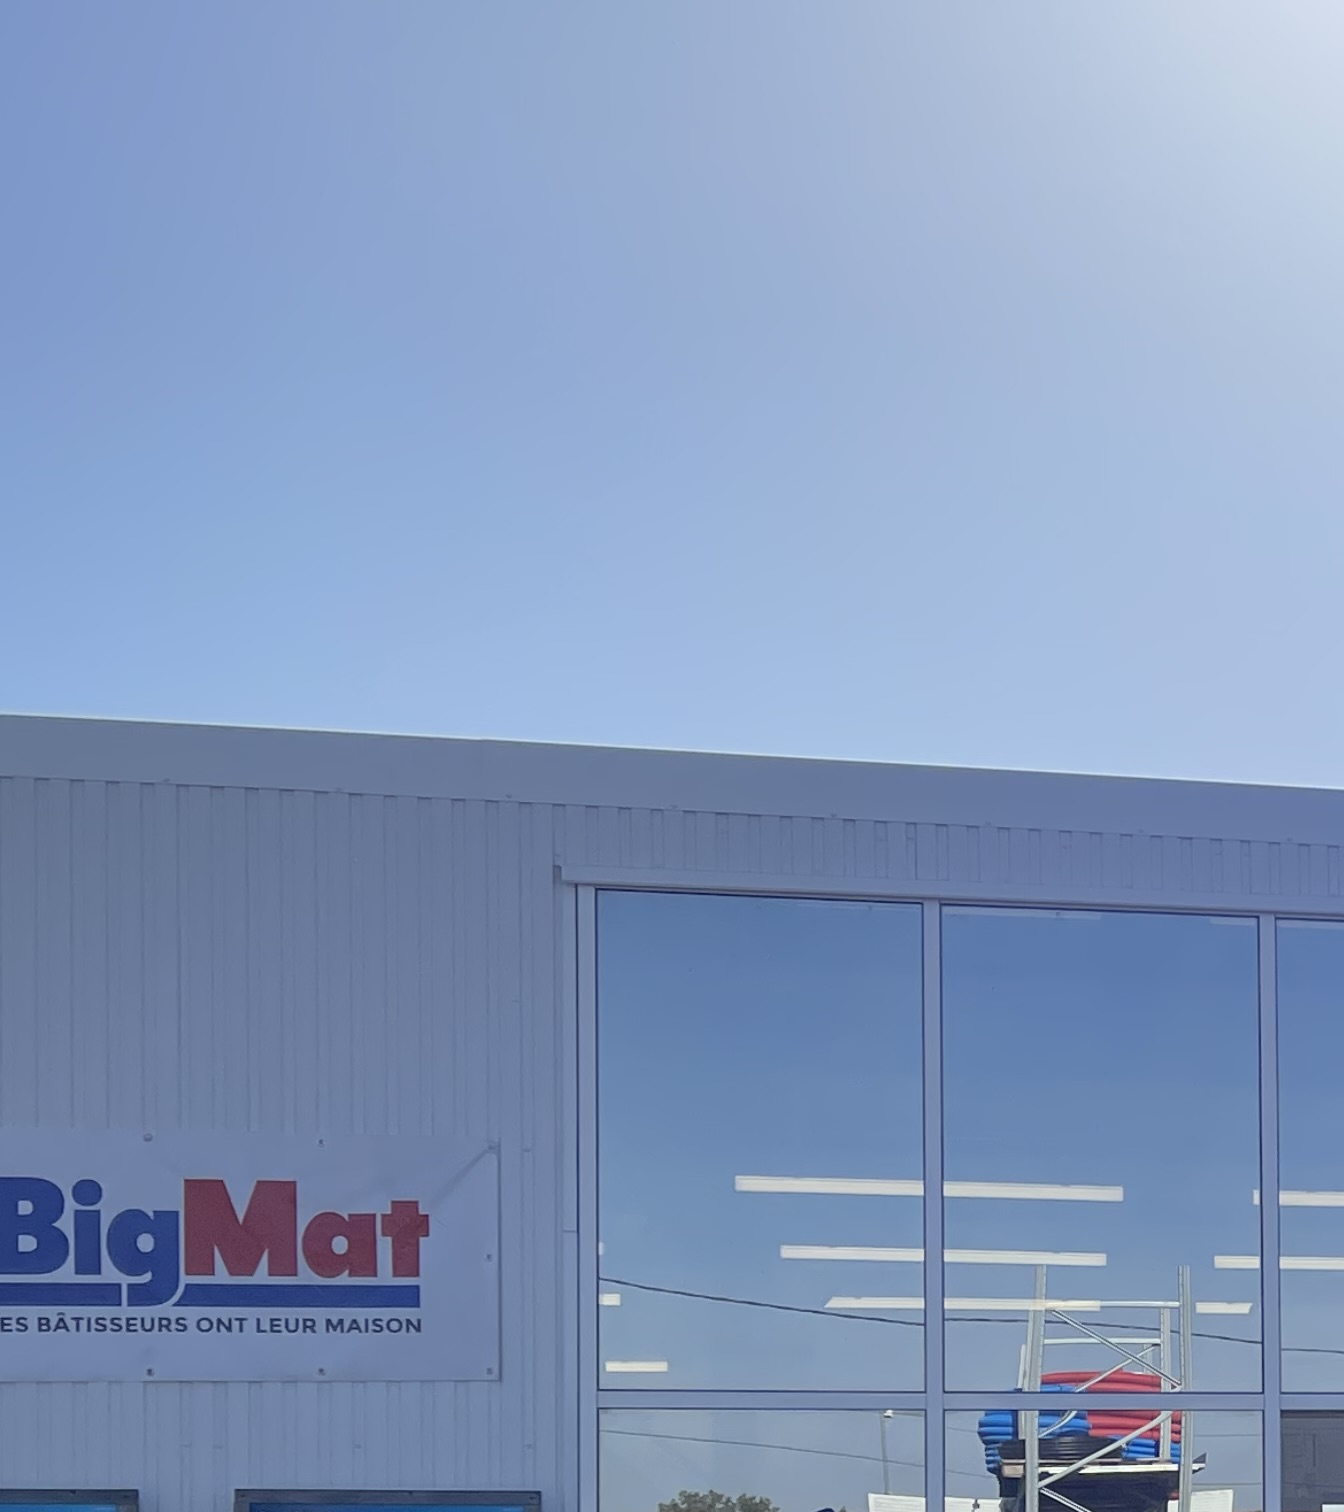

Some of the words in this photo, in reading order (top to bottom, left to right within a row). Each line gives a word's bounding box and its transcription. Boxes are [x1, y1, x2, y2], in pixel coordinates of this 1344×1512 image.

[0, 1176, 430, 1307] BigMat
[37, 1311, 188, 1334] BÂTISSEURS
[196, 1317, 248, 1334] ONT
[256, 1317, 317, 1334] LEUR
[325, 1317, 422, 1334] MAISON
